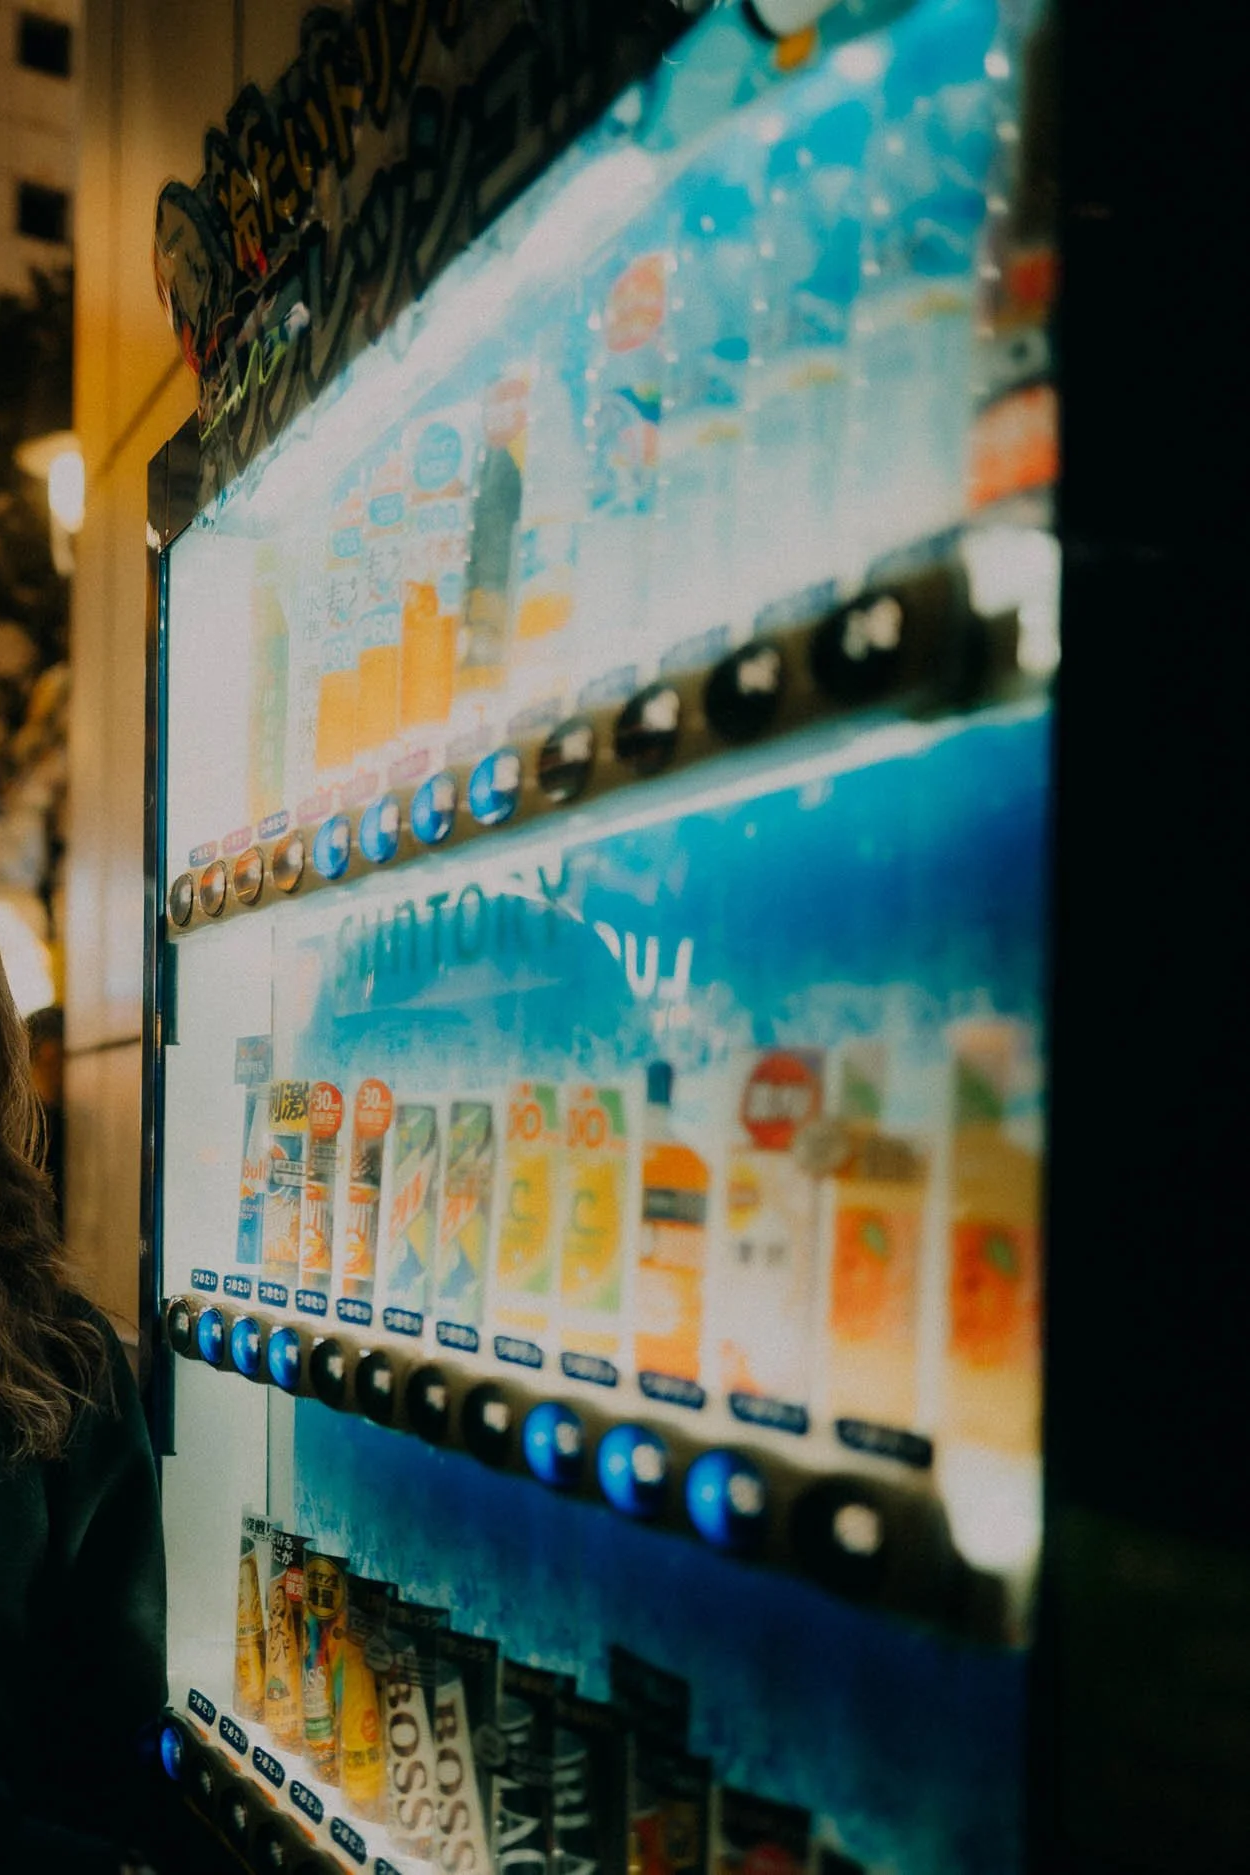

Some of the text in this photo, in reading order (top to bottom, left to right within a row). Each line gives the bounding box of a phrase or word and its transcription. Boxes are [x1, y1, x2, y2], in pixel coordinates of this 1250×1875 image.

[192, 1271, 217, 1287] つめたい
[225, 1279, 250, 1294] つめたい
[261, 1285, 286, 1302] つめたい
[297, 1292, 326, 1312] つめたい
[339, 1301, 370, 1320] つめたい
[190, 1691, 214, 1722] つめたい
[222, 1719, 247, 1751] つめたい
[254, 1750, 284, 1782] つめたい
[387, 1672, 434, 1834] BOSS
[292, 1783, 322, 1818] つめたい
[434, 1698, 478, 1873] BOSS
